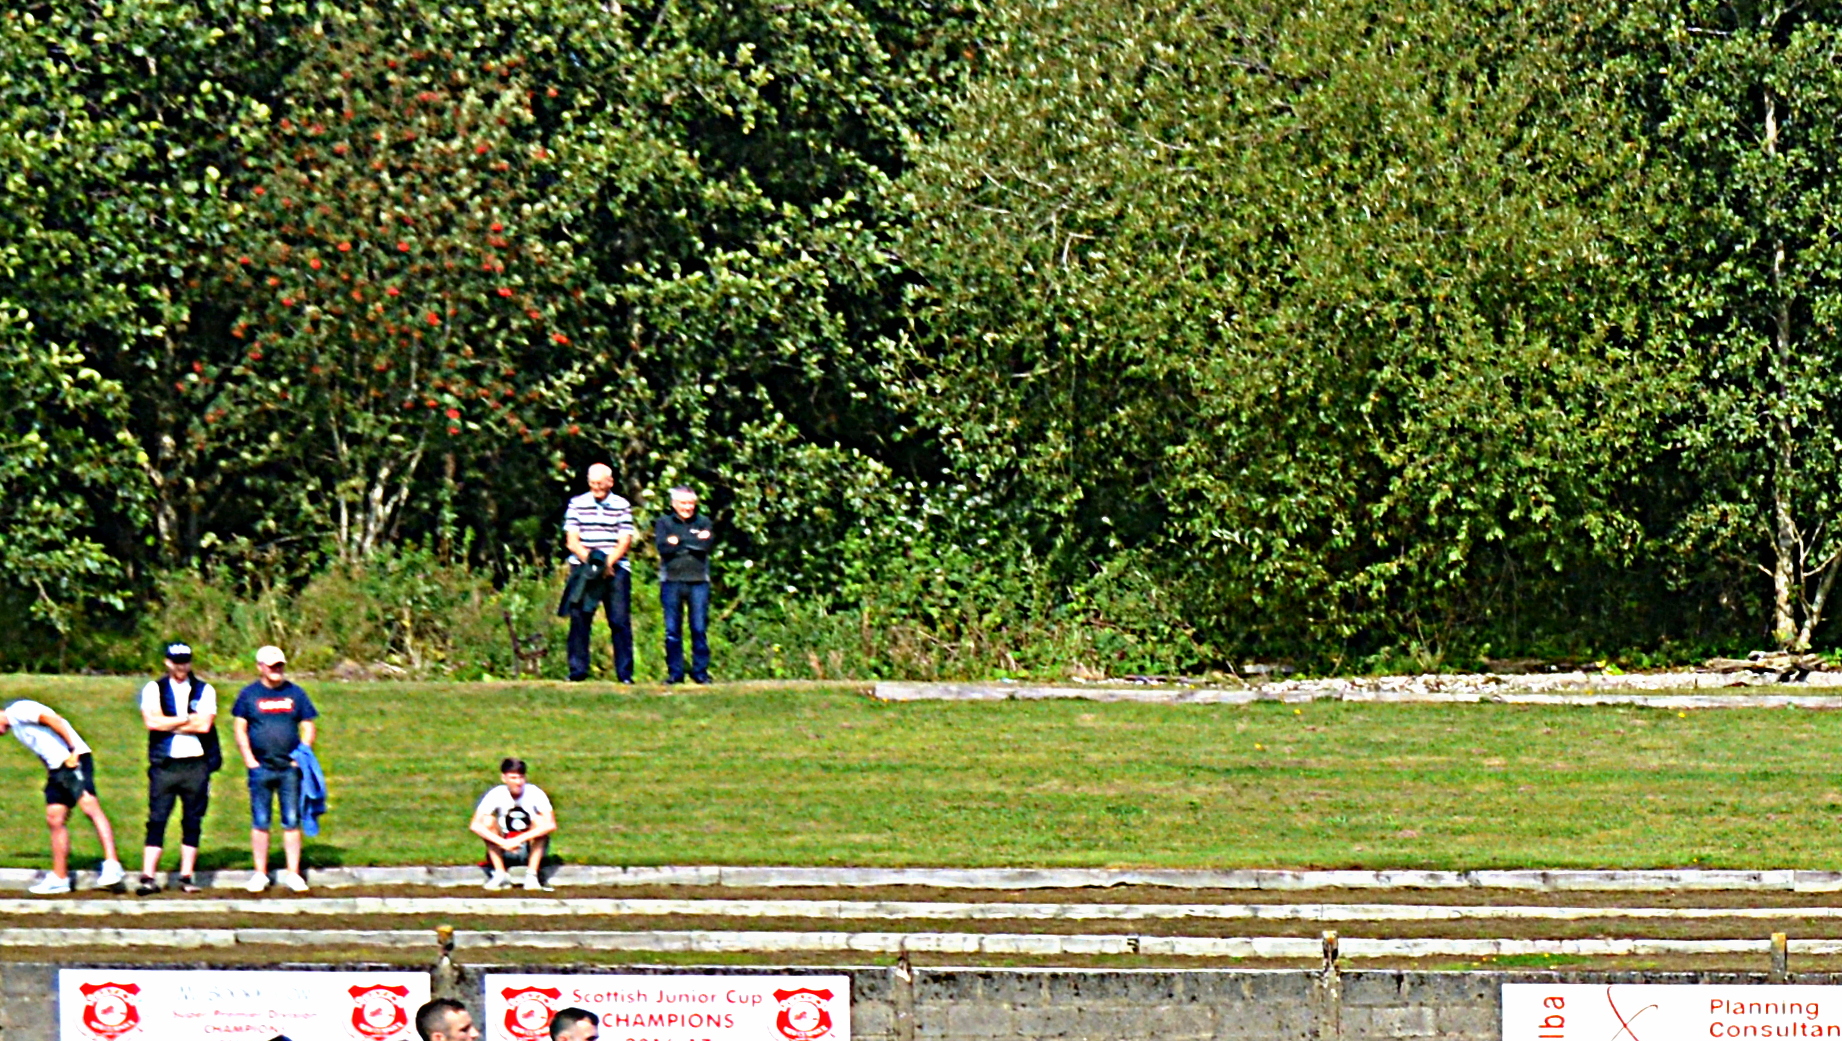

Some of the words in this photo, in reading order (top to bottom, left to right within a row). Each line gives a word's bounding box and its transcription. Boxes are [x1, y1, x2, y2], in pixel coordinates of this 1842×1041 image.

[573, 988, 648, 1004] Scottish
[656, 989, 717, 1004] Junior
[725, 989, 763, 1007] Cup
[1709, 999, 1820, 1020] Planning
[602, 1012, 735, 1029] CHAMPIONS
[204, 1024, 286, 1036] CHAMPION
